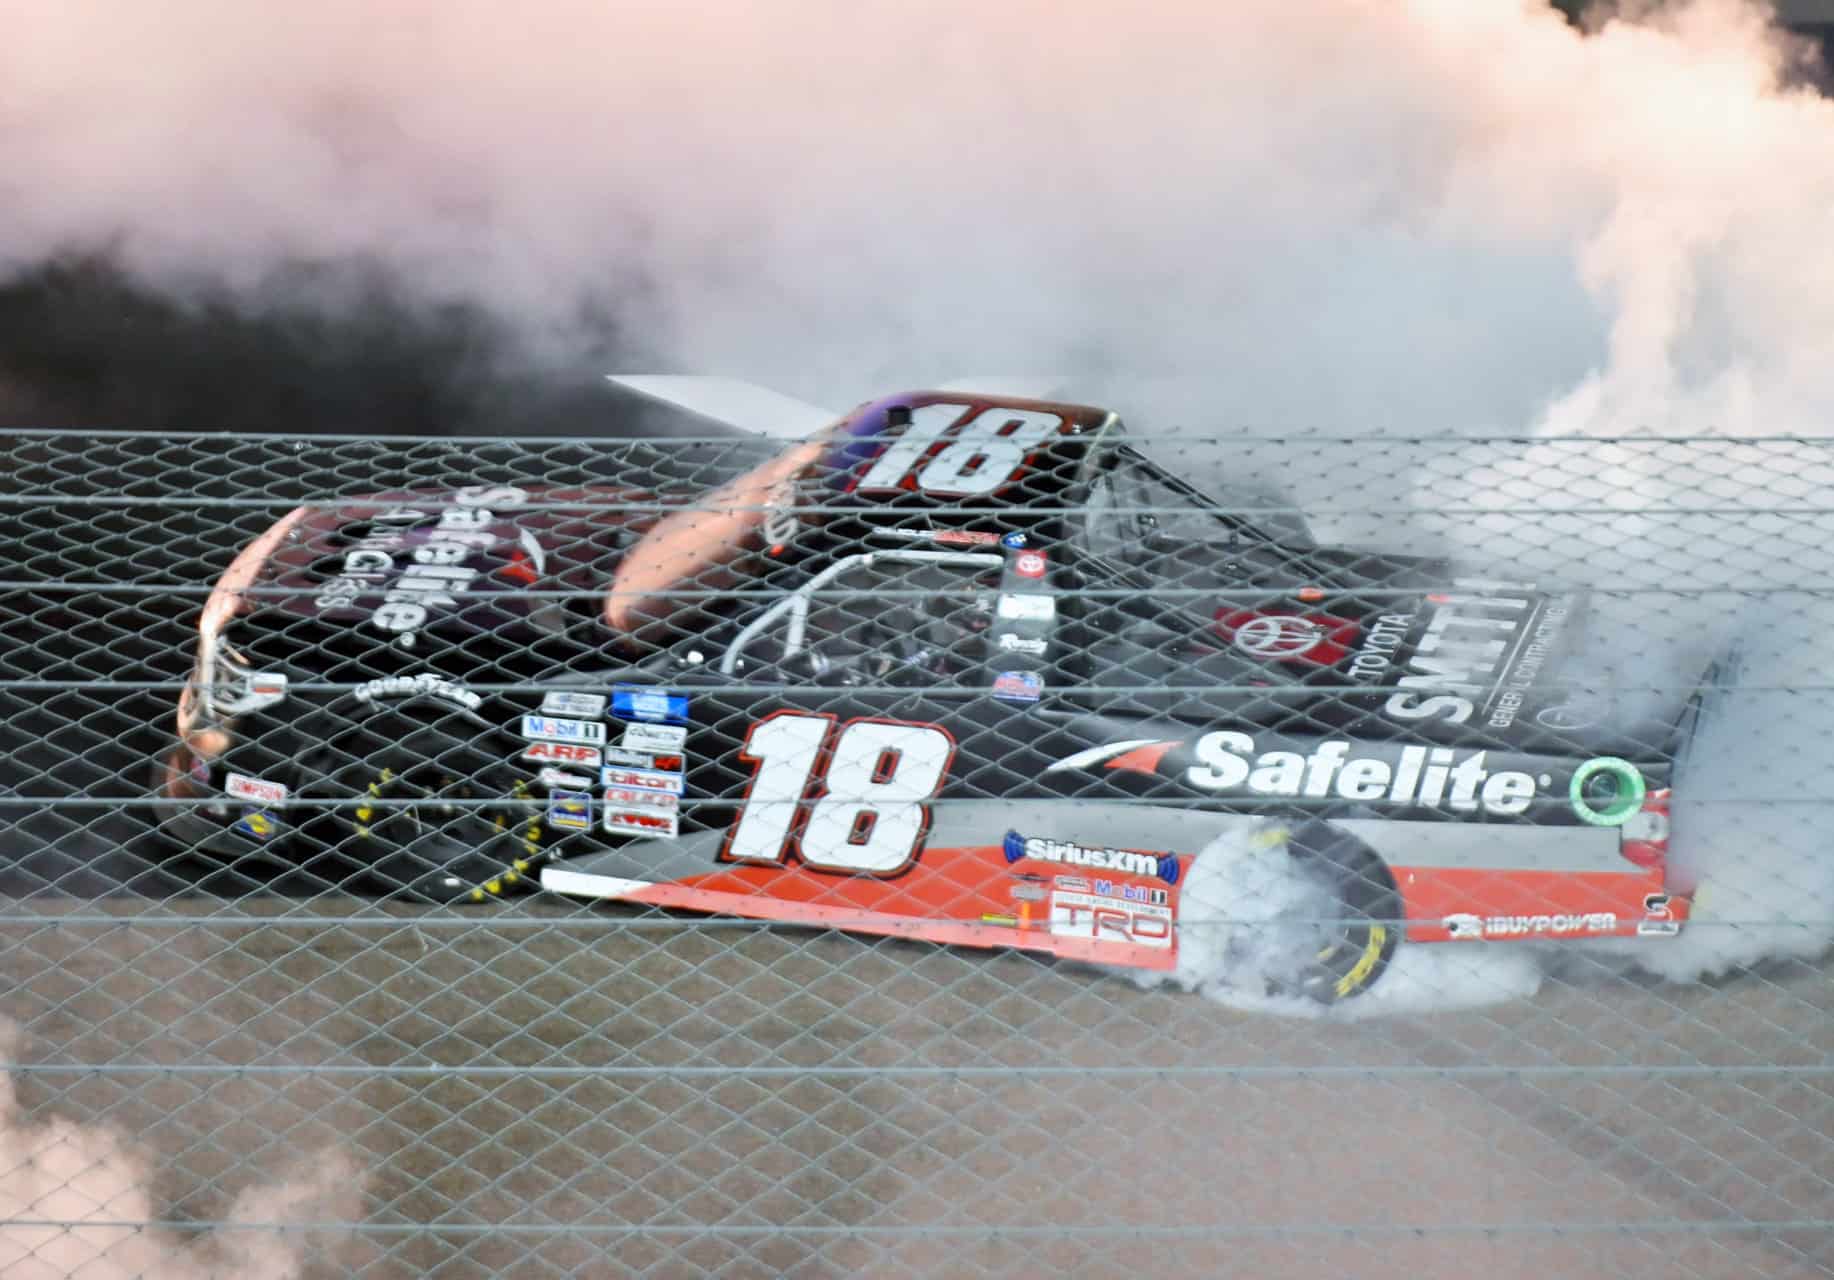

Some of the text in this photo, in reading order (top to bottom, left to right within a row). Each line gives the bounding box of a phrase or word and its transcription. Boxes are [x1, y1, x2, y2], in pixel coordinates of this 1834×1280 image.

[857, 403, 1064, 493] 18
[1350, 613, 1411, 685] TOYOTA
[527, 744, 598, 761] ARP
[529, 718, 577, 736] Mobil
[608, 771, 679, 790] tilton
[720, 709, 955, 878] 18
[1186, 730, 1536, 815] Safelite
[1055, 903, 1169, 942] TRD
